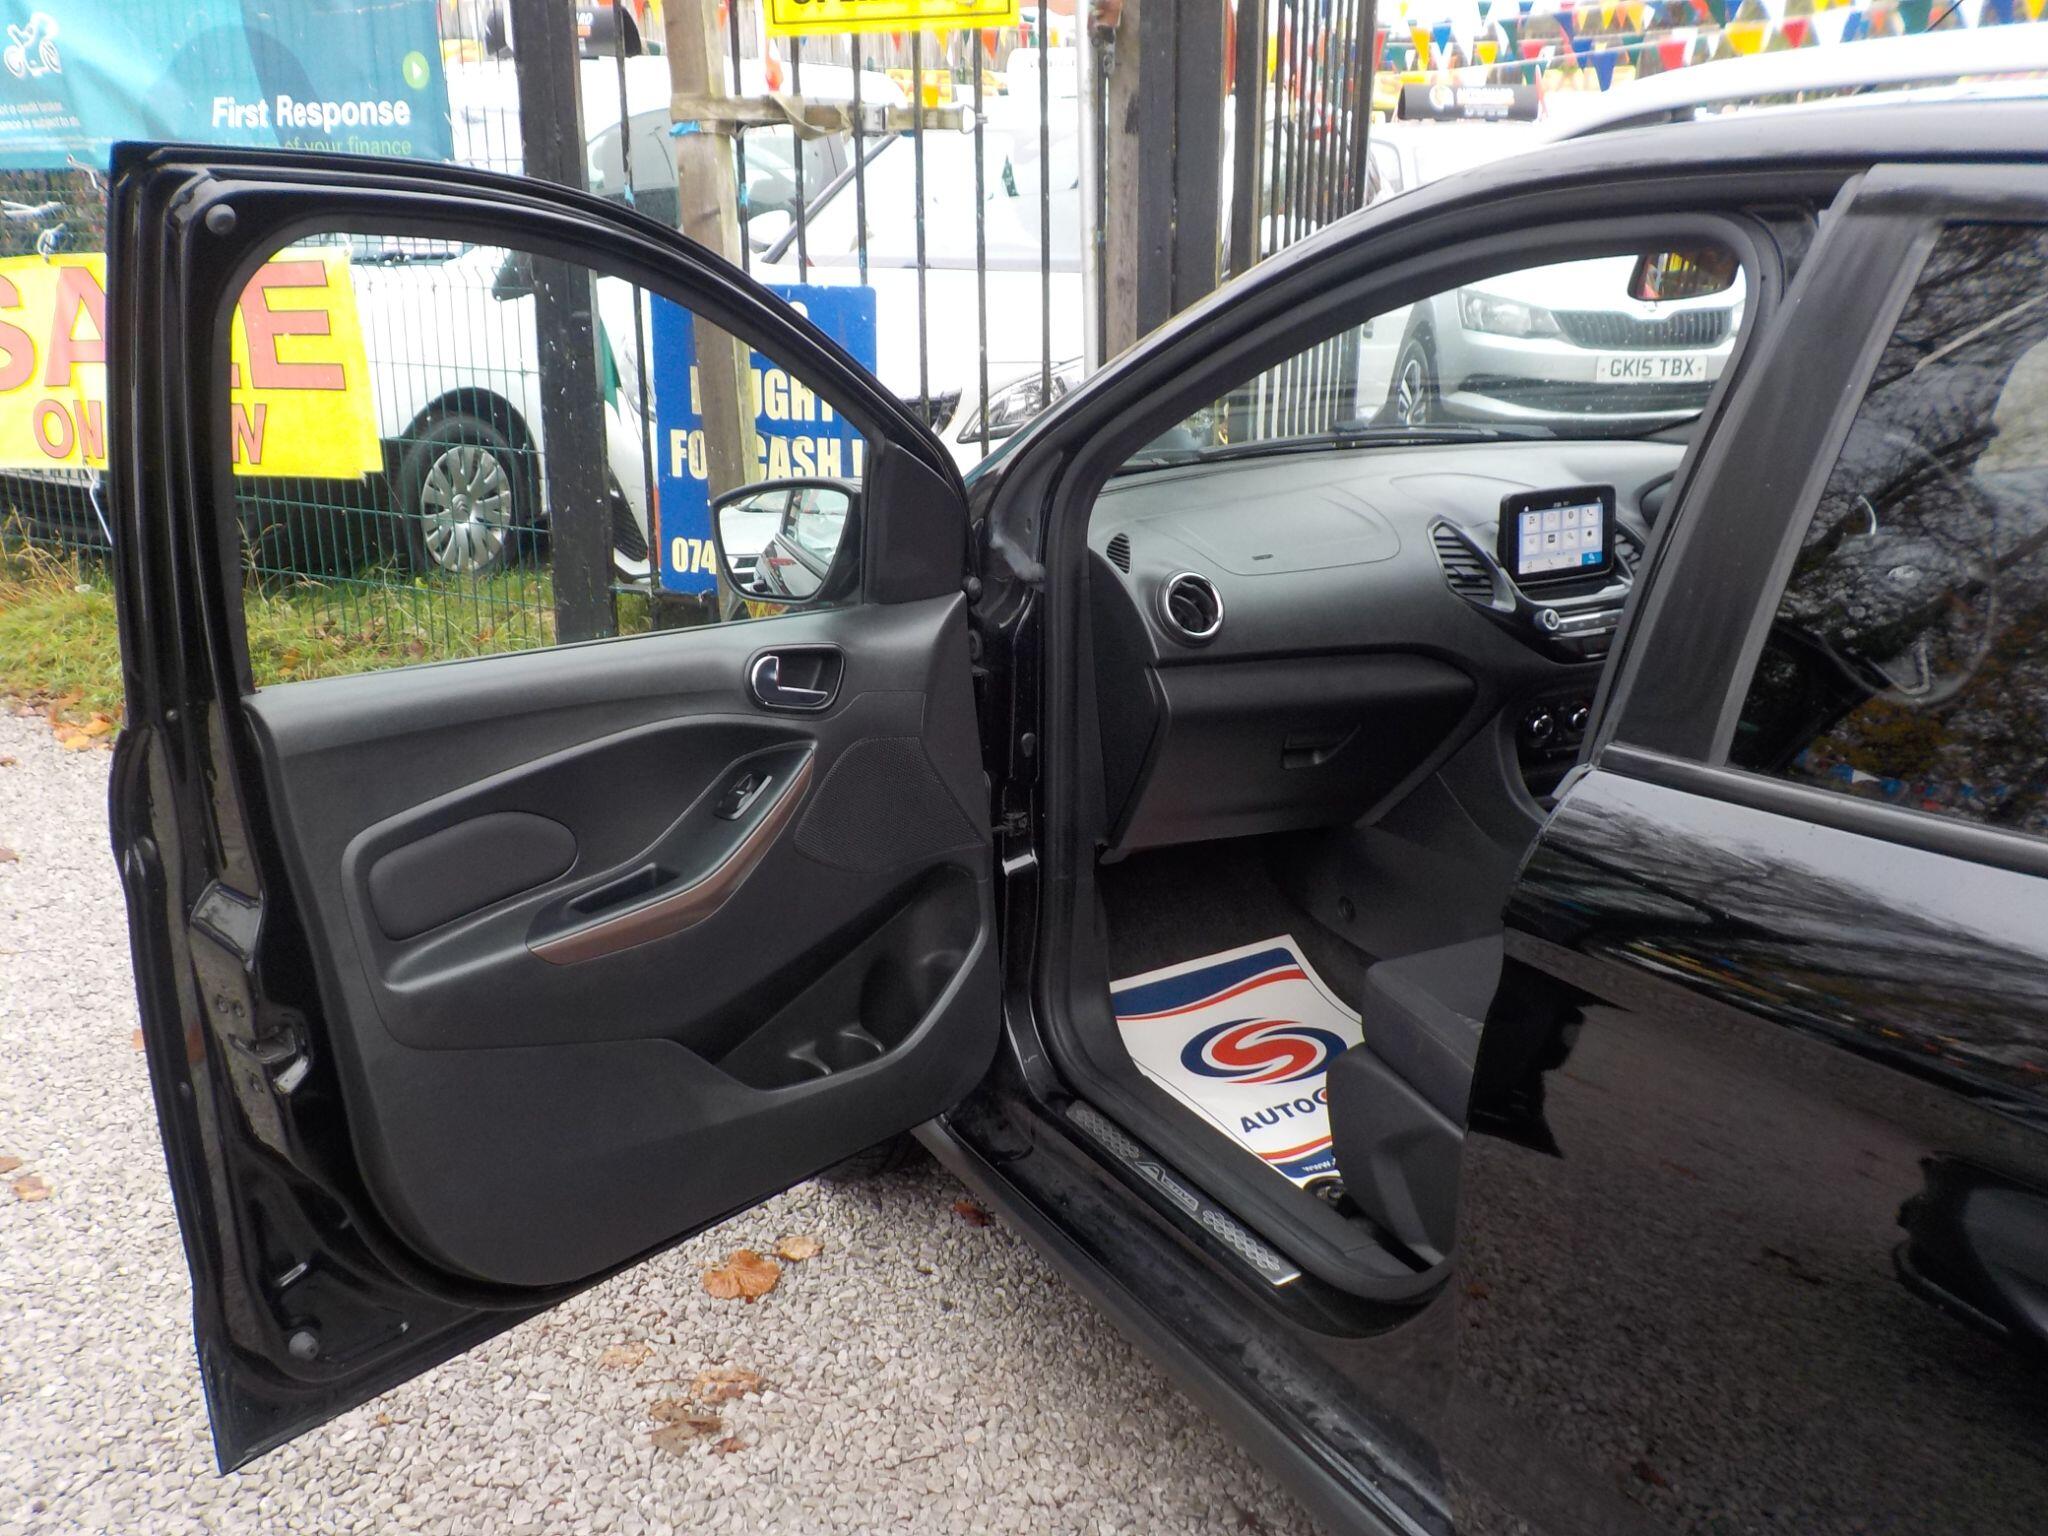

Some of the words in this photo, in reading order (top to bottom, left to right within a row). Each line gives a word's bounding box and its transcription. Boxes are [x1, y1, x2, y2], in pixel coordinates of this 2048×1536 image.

[212, 97, 268, 127] First
[276, 95, 410, 133] Response
[347, 136, 412, 155] finance
[1610, 359, 1653, 377] GK15
[1660, 359, 1695, 377] TBX
[670, 429, 708, 480] FO
